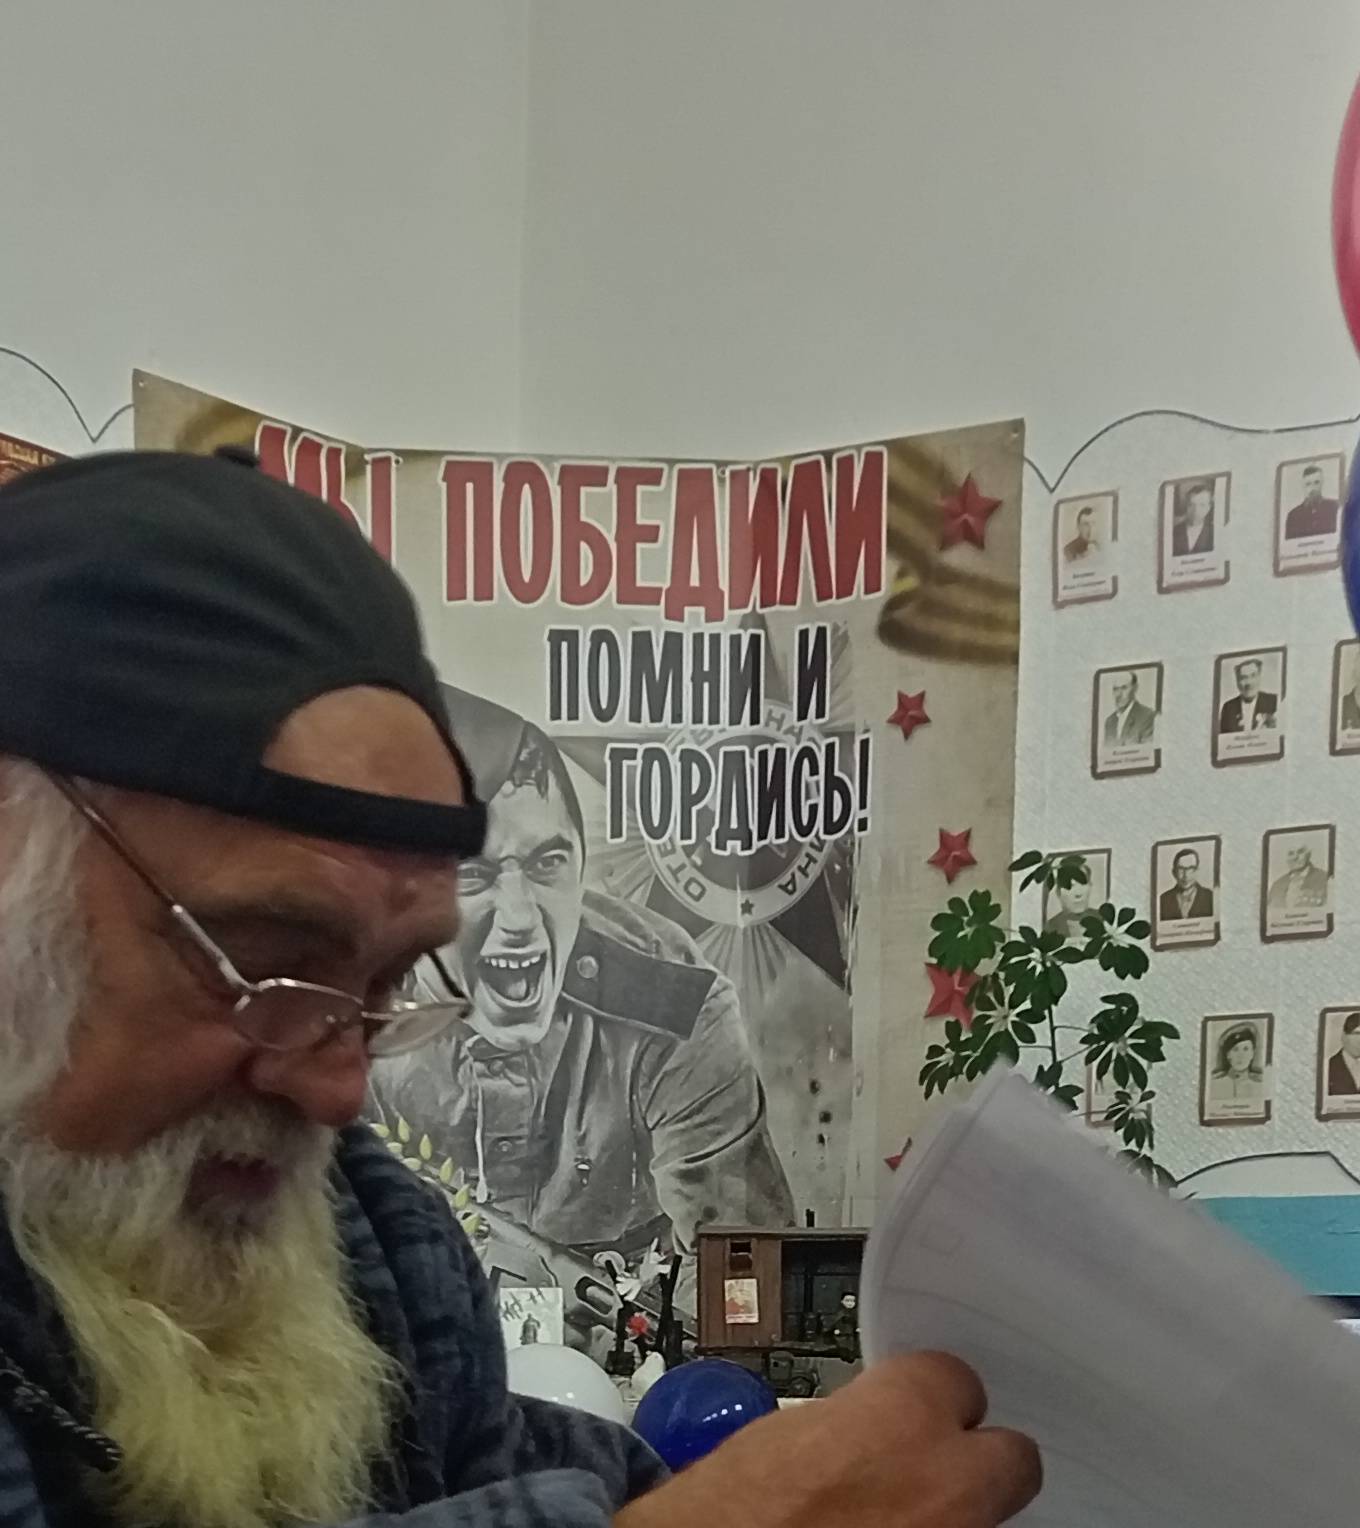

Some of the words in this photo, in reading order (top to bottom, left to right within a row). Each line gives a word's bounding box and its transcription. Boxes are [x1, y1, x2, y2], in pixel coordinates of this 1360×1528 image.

[439, 446, 888, 625] ПОБЕДИЛИ
[546, 623, 766, 728] ПОМНИ
[793, 620, 831, 725] И
[605, 728, 873, 856] ГОРДИСЬ!
